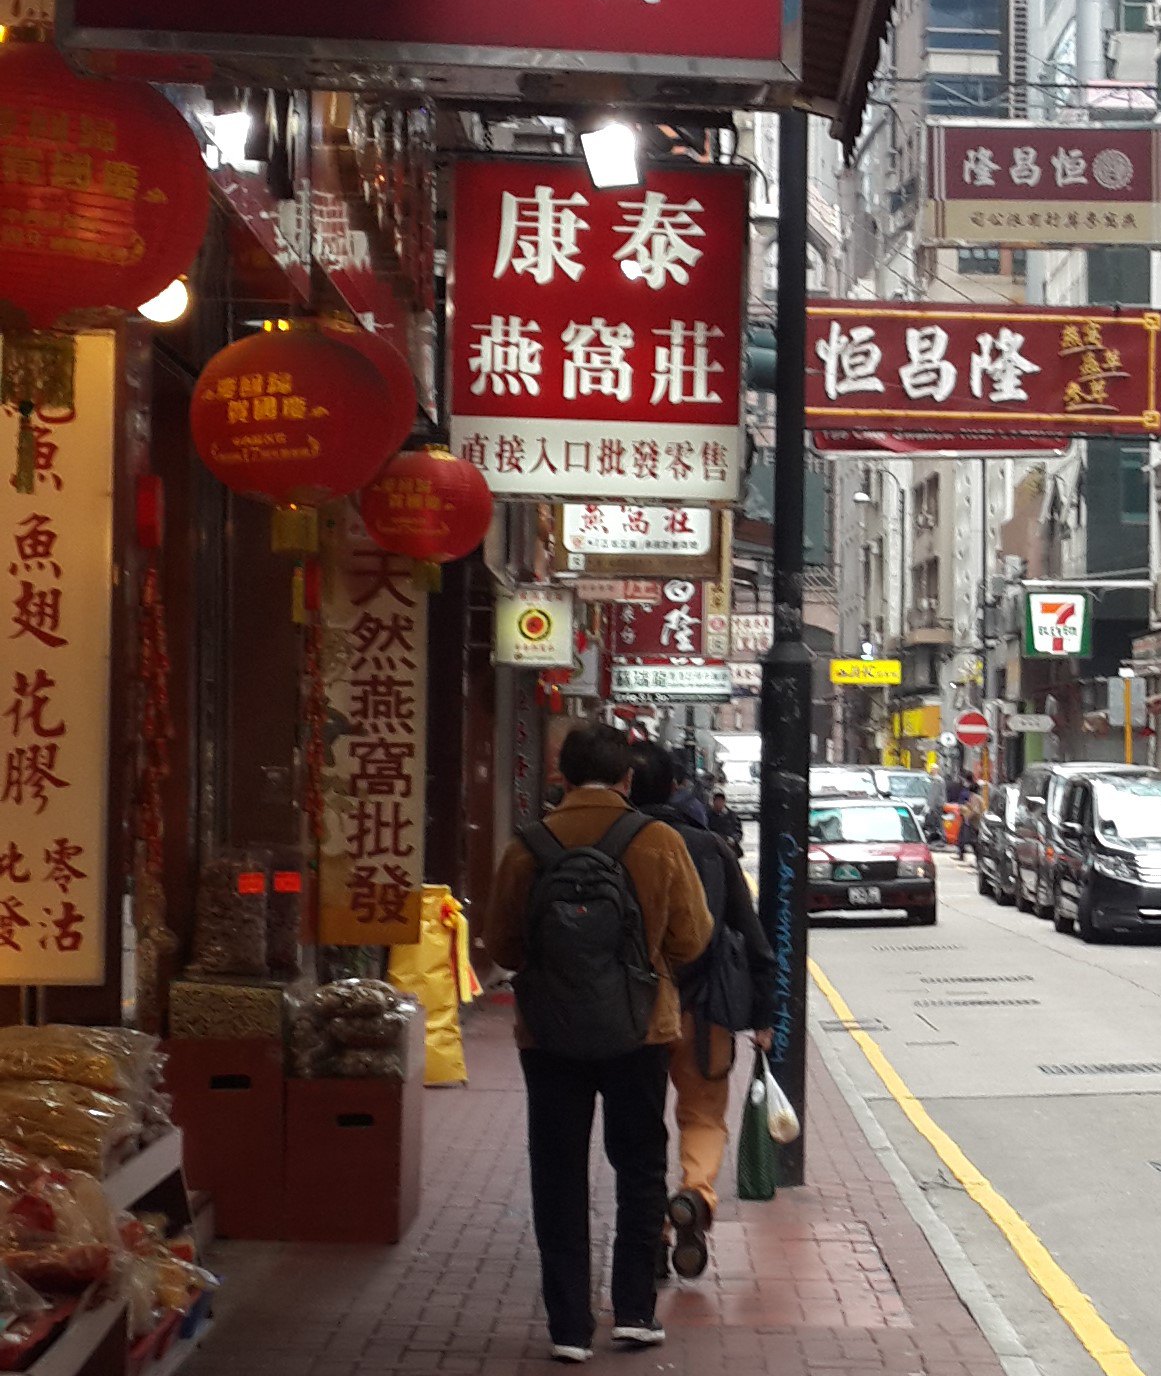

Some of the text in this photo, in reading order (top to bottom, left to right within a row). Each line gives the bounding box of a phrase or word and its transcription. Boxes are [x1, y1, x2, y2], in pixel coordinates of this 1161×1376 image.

[491, 184, 709, 292] 康泰
[468, 315, 727, 408] 燕窩莊
[815, 320, 1042, 403] 恒昌隆
